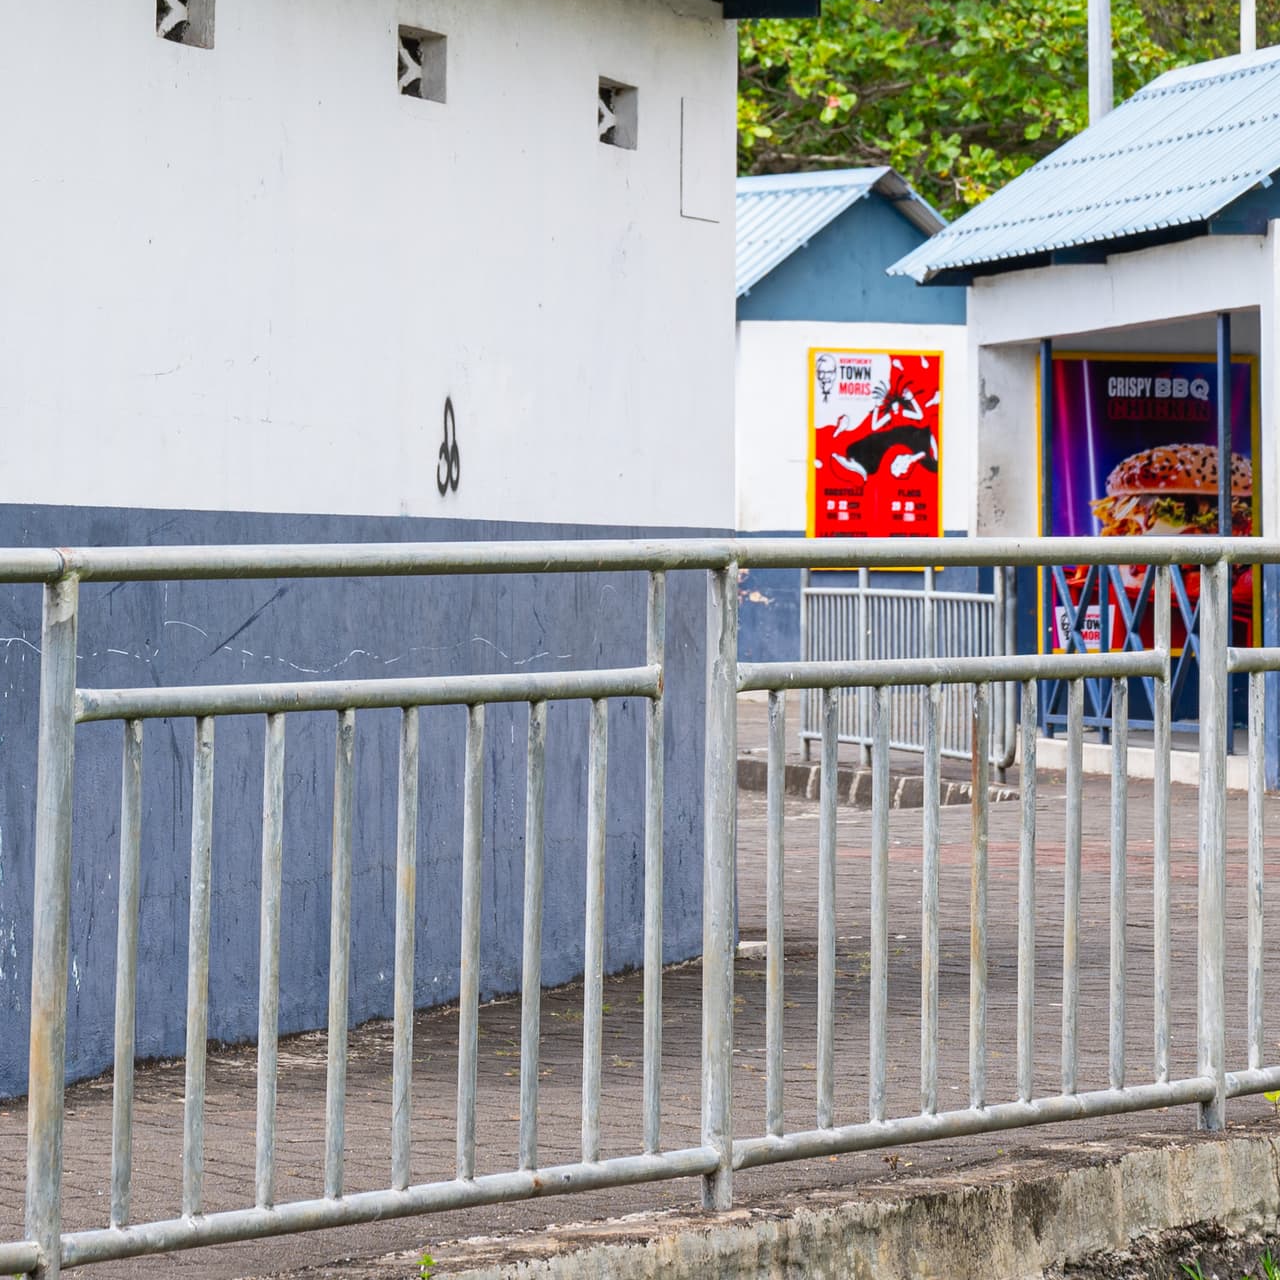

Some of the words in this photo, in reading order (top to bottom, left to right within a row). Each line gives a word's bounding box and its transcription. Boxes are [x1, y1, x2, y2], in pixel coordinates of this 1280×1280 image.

[840, 366, 872, 380] TOWN
[839, 382, 872, 396] MORIS
[1108, 376, 1152, 398] CRISPY
[1154, 377, 1210, 401] BBQ
